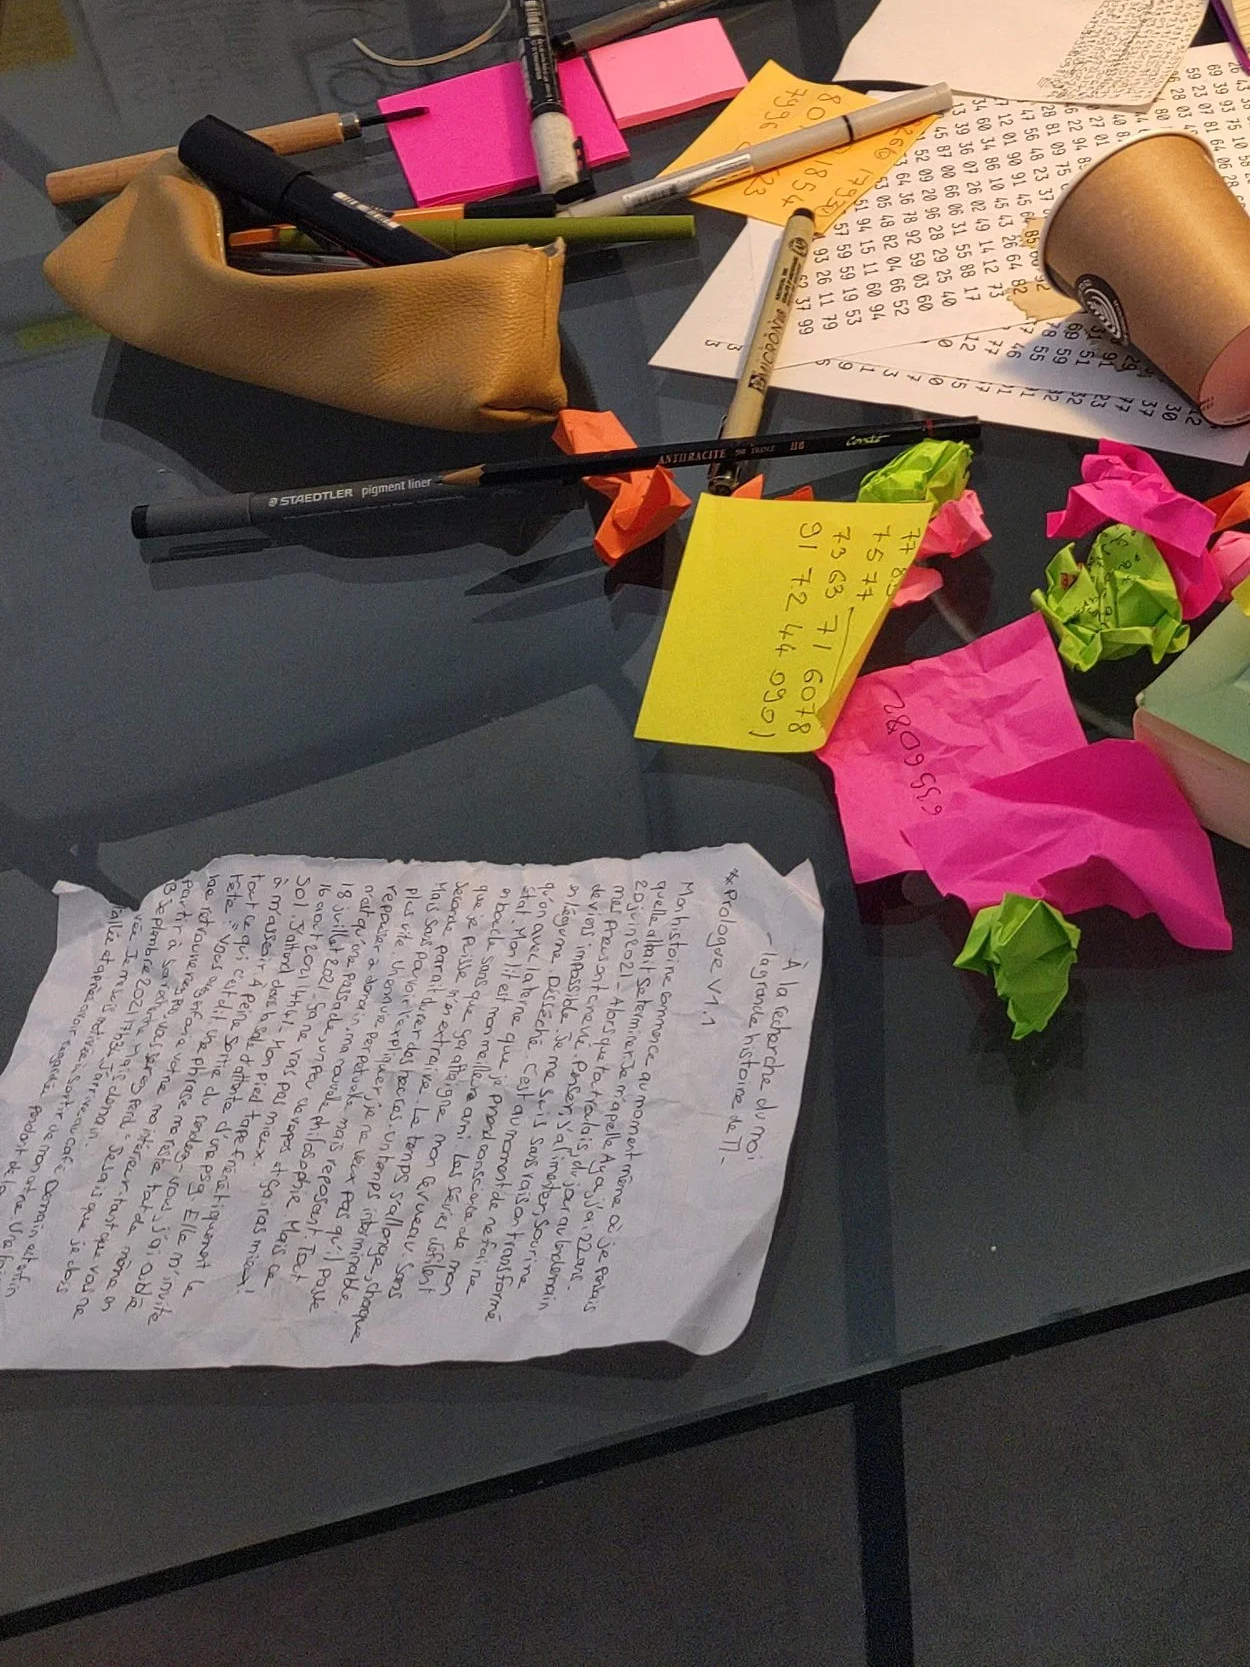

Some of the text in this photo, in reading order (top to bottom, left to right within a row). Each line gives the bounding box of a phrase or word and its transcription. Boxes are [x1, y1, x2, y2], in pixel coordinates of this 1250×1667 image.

[1235, 79, 1250, 92] 43
[813, 247, 839, 331] 93 26 11 79
[795, 296, 815, 336] 37 99
[1063, 322, 1084, 340] 69
[1028, 345, 1050, 362] 55
[1138, 399, 1158, 418] 37
[279, 478, 433, 506] STAEDTLER pigment liner
[798, 521, 823, 550] 91
[866, 525, 891, 562] 75
[898, 527, 921, 555] 77
[785, 566, 813, 612] 72
[824, 569, 847, 599] 63
[774, 623, 804, 658] 44
[812, 614, 839, 651] 71
[787, 668, 824, 734] 6078
[674, 881, 695, 913] Mon
[781, 957, 809, 971] À
[775, 981, 800, 998] la
[759, 1005, 792, 1091] recherche
[731, 1033, 761, 1110] histoire
[754, 1098, 779, 1120] du
[624, 1094, 650, 1160] moment
